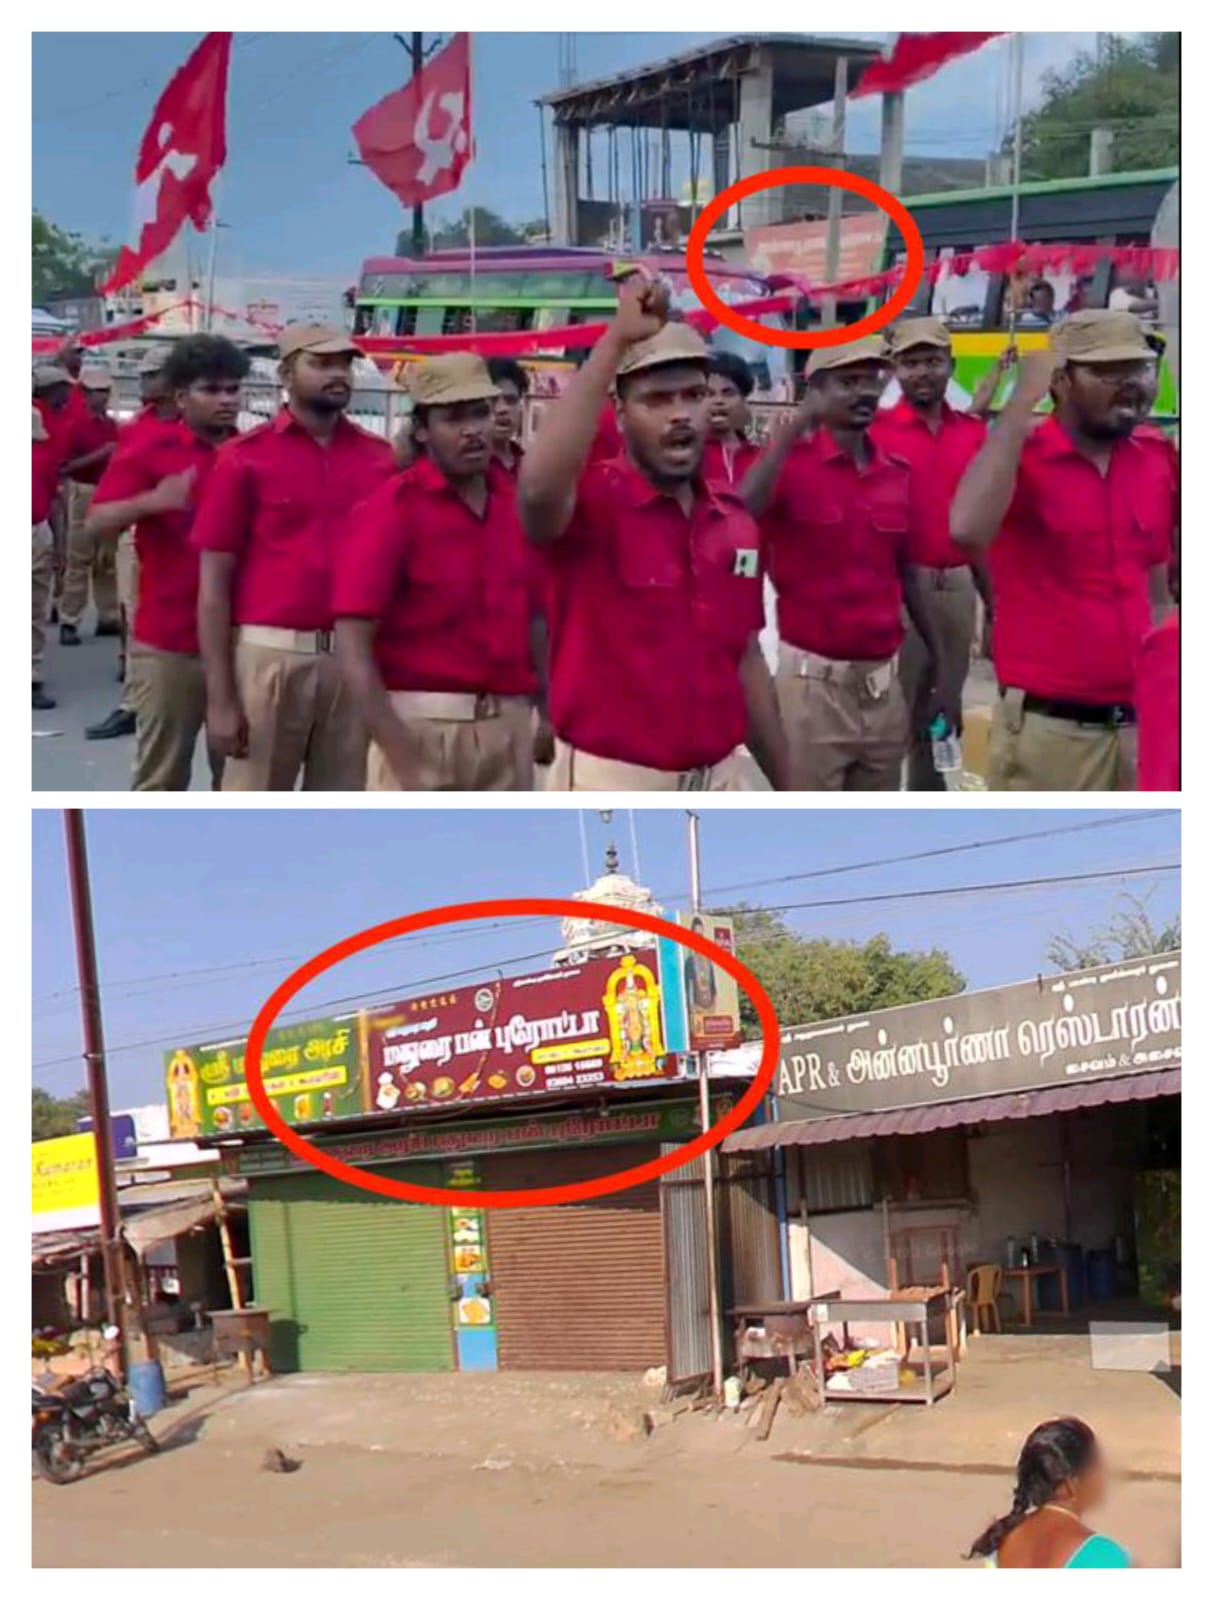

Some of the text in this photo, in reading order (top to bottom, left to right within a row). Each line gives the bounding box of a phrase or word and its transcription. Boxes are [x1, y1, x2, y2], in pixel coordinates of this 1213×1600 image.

[382, 1036, 453, 1074] மதுரை
[778, 1052, 827, 1096] APR
[827, 1061, 841, 1087] &
